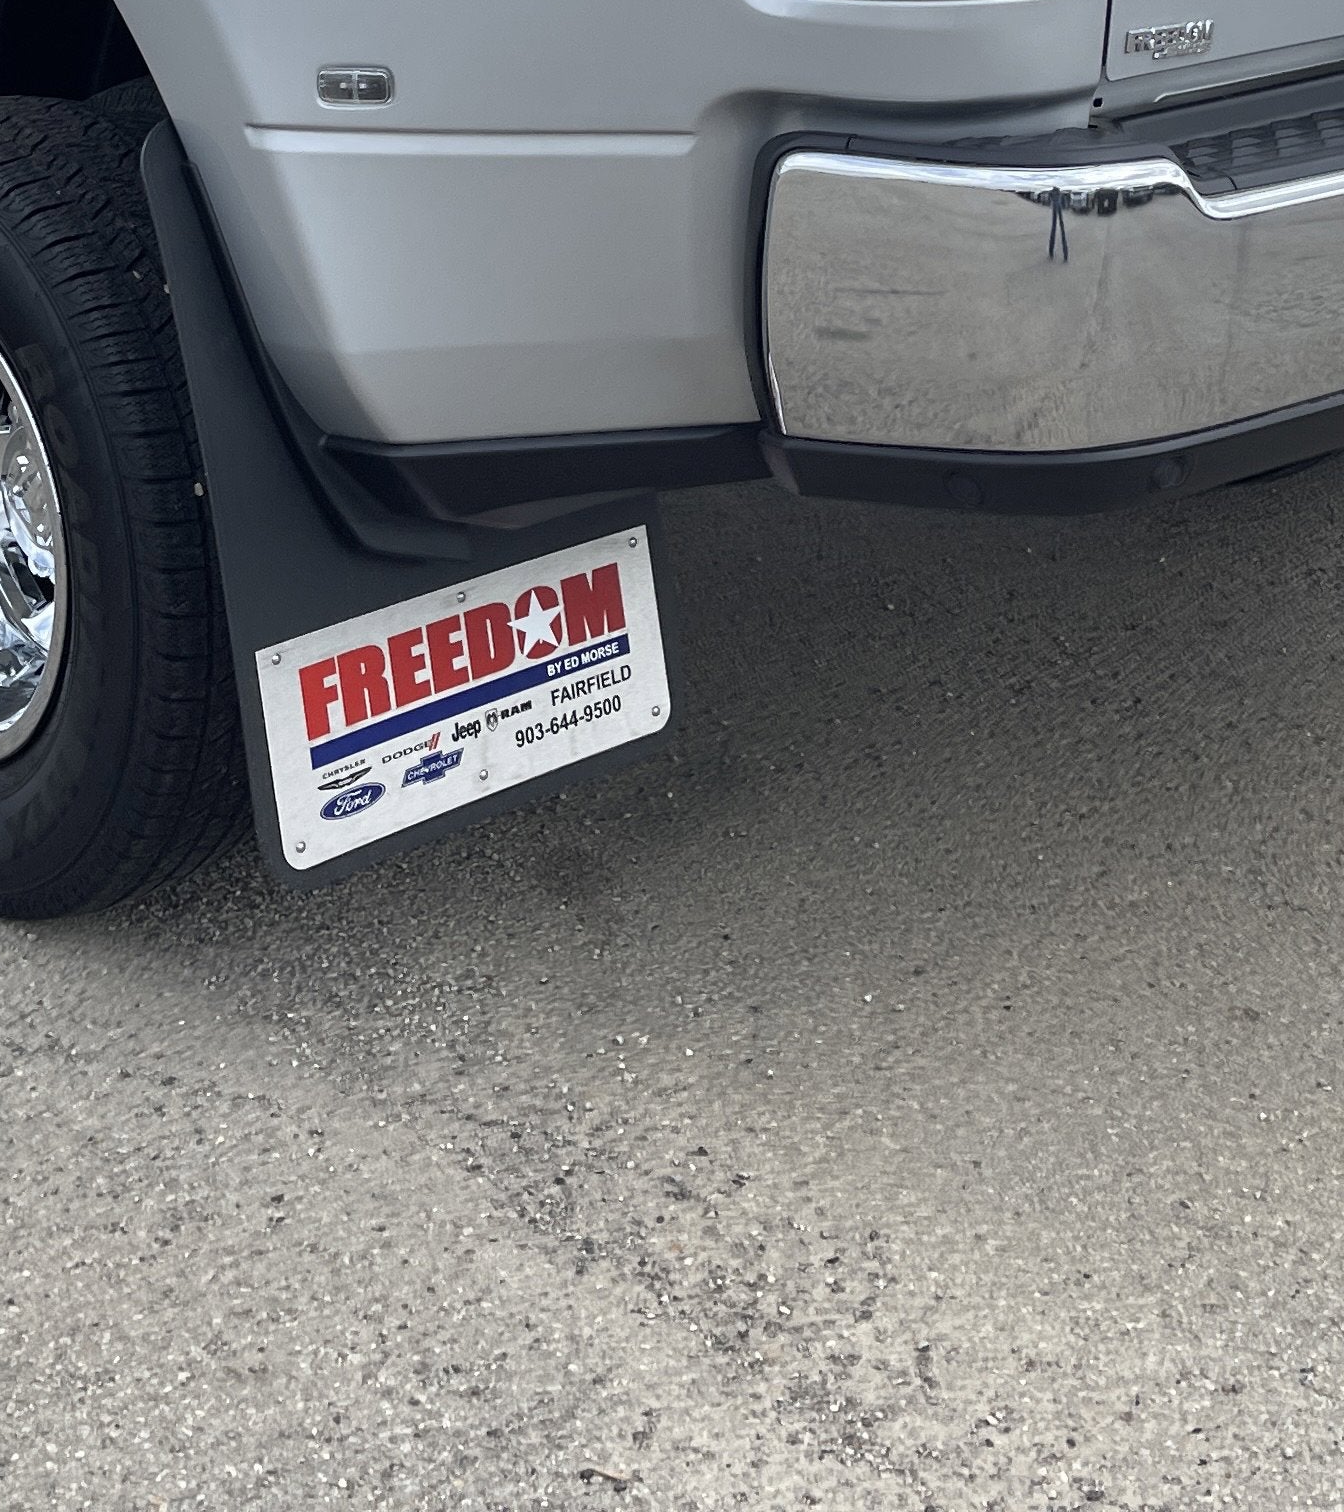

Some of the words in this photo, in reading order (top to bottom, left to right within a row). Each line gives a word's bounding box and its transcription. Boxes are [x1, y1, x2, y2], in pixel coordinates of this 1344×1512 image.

[298, 562, 626, 742] FREEDOM
[547, 662, 562, 677] BY
[564, 656, 579, 671] ED
[581, 642, 619, 665] MORSE
[551, 664, 632, 706] FAIRFIELD
[500, 700, 533, 720] RAM
[516, 694, 621, 748] 903-644-9500
[451, 719, 482, 742] Jeep
[322, 758, 366, 780] CHRYSLER
[407, 754, 459, 781] CHEVROLET
[334, 789, 372, 816] Ford
